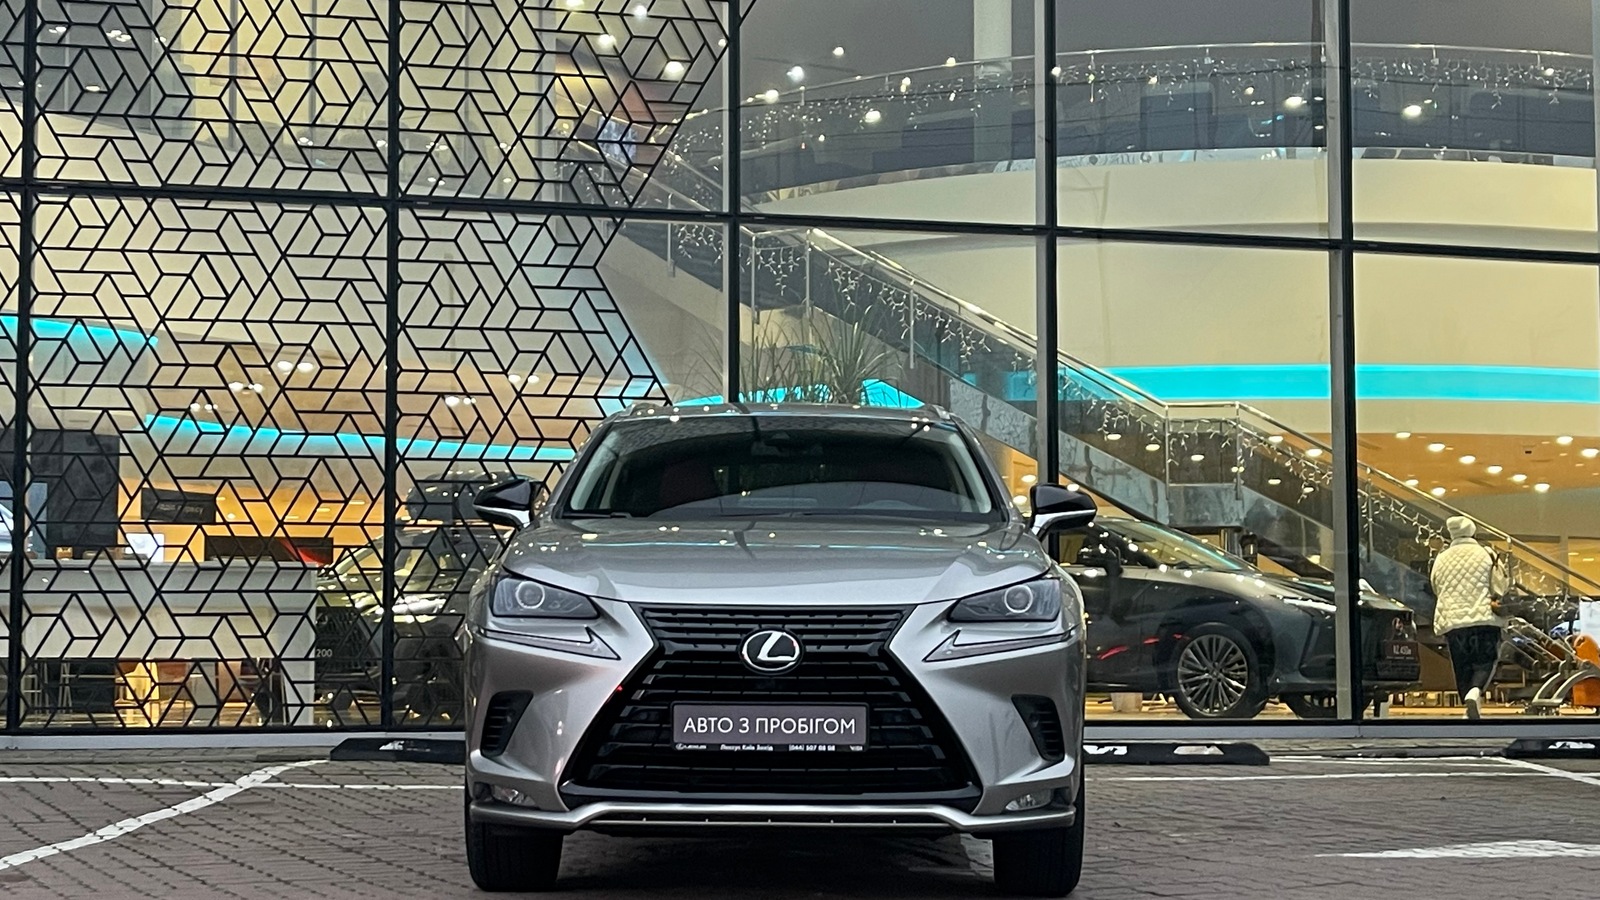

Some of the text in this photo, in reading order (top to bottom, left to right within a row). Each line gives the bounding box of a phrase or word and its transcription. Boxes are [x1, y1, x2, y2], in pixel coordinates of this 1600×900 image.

[316, 648, 333, 658] 200
[683, 717, 734, 734] АВТО
[755, 717, 856, 735] ПРОБІГОМ
